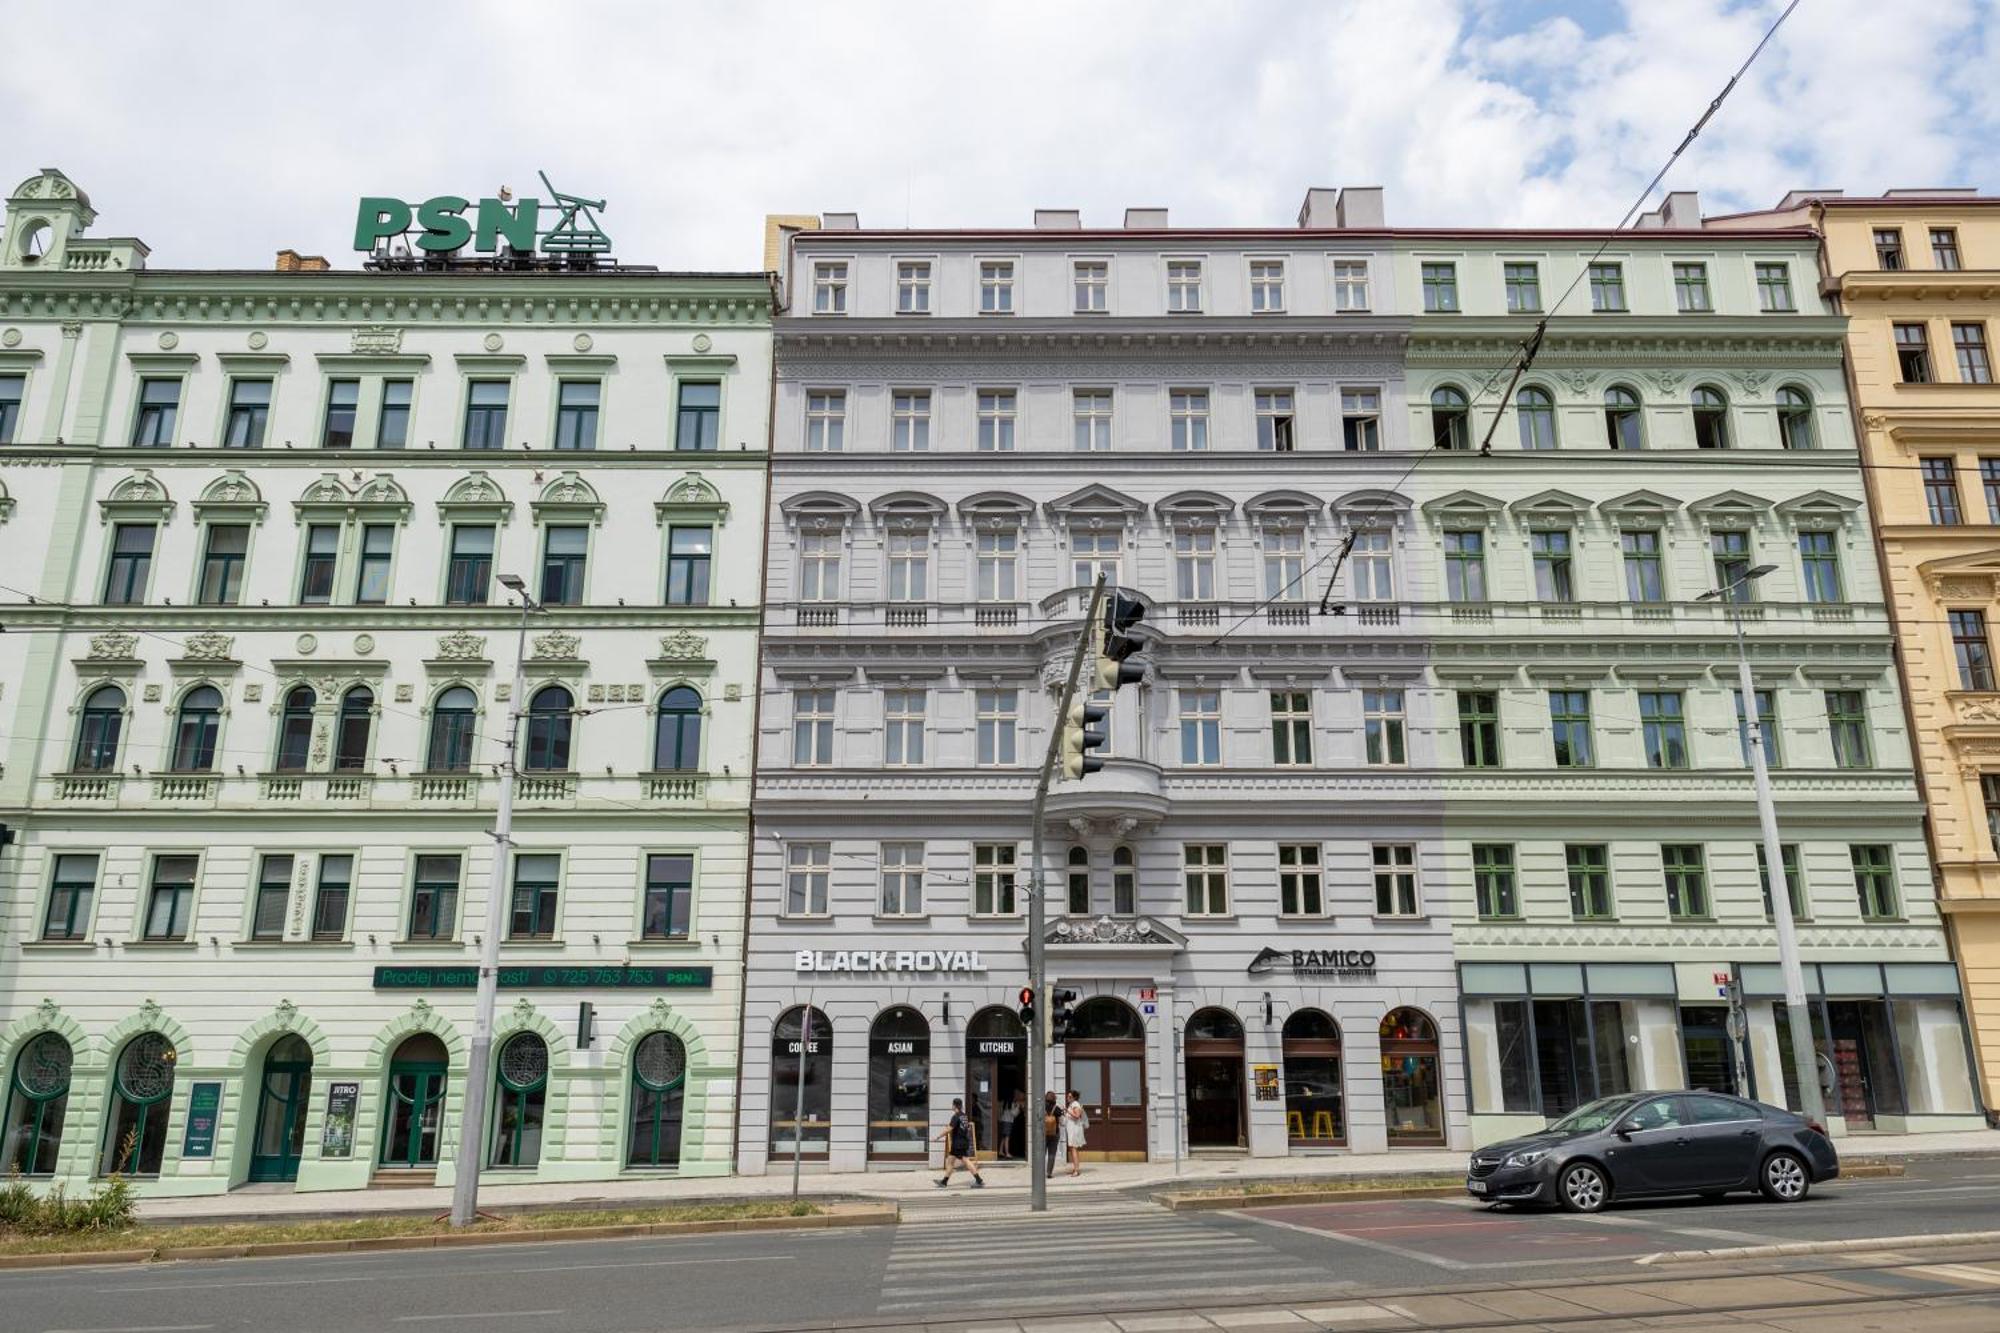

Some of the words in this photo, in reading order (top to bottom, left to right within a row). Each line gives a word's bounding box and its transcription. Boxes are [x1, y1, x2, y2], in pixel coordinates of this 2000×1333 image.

[354, 196, 539, 252] PSN
[795, 950, 888, 972] BLACK
[895, 950, 987, 972] ROYAL
[1292, 950, 1376, 967] BAMICO
[382, 970, 432, 986] Prodej
[560, 969, 588, 984] 725
[594, 969, 621, 984] 753
[627, 969, 654, 984] 753
[666, 972, 692, 984] PSN
[788, 1041, 819, 1053] COEE
[887, 1042, 913, 1054] ASIAN
[979, 1041, 1014, 1053] KITCHEN
